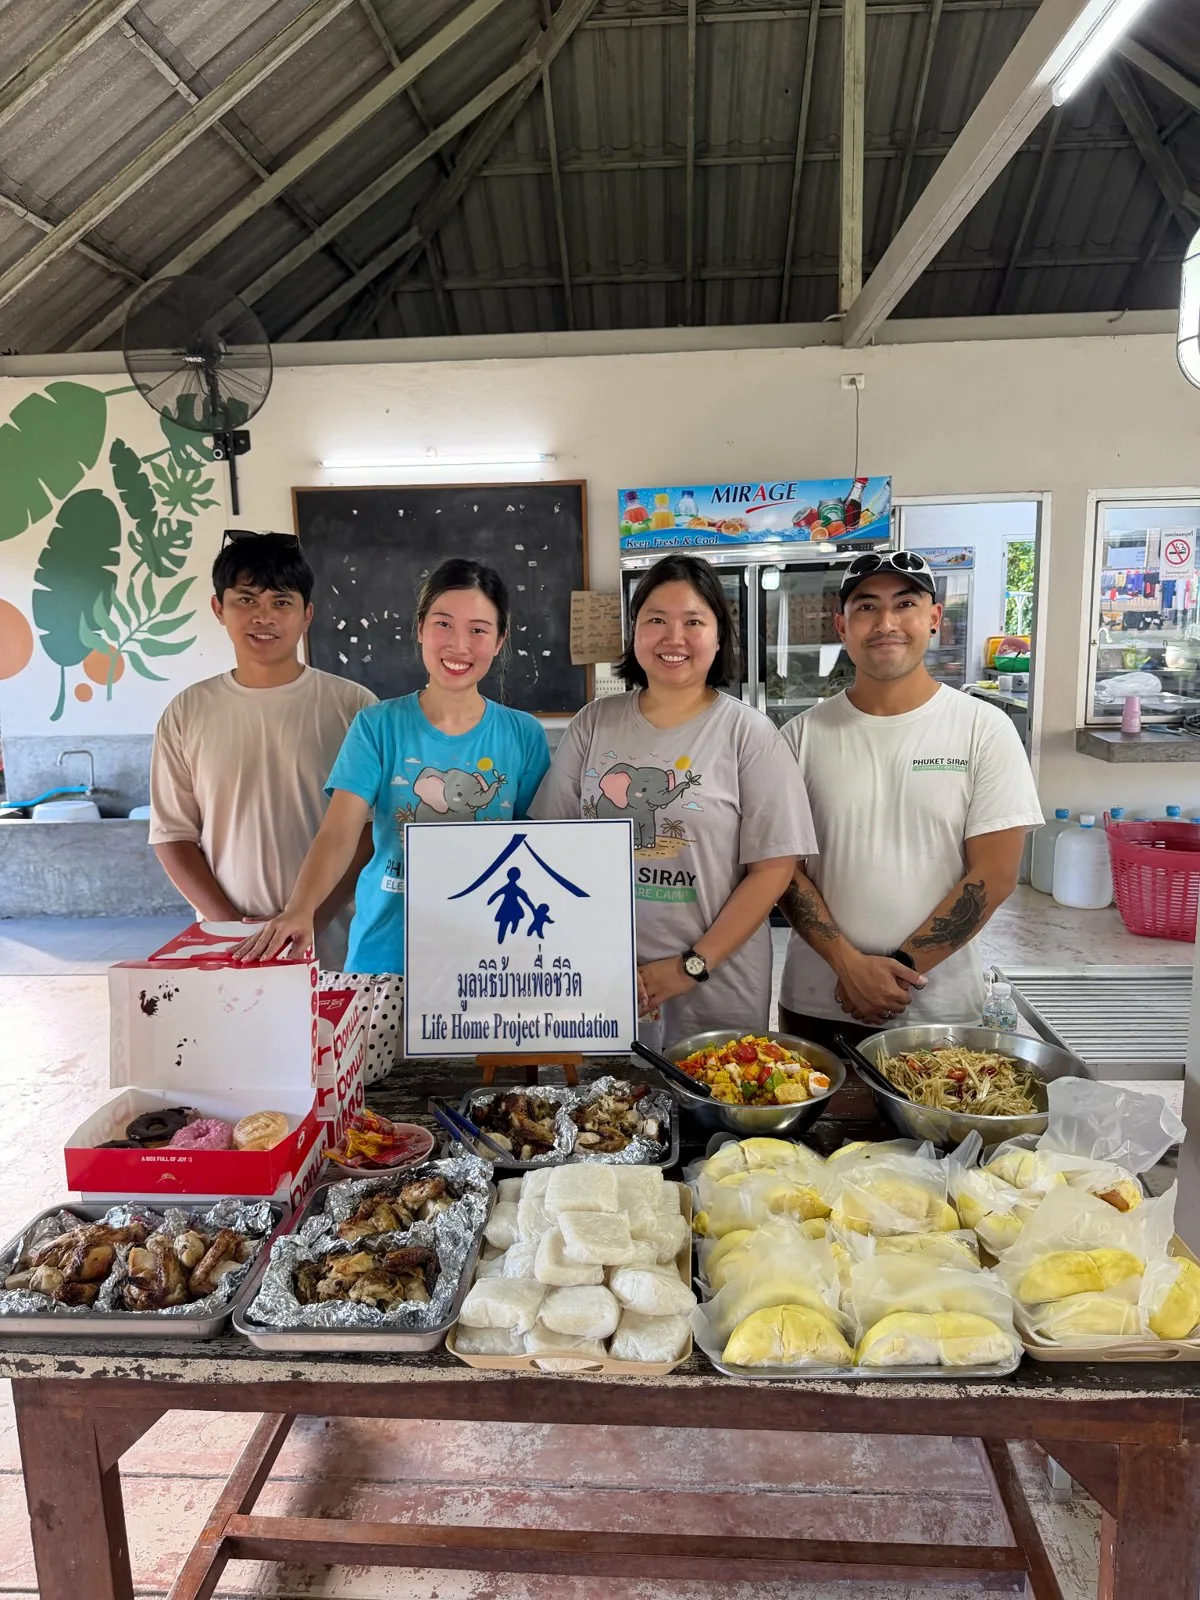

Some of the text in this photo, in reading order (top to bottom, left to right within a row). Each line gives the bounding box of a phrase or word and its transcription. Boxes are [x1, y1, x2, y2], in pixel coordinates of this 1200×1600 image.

[711, 482, 799, 504] MIRAGE
[626, 535, 719, 549] Keep Fresh & Cool
[912, 758, 969, 766] PHUKET SIRAY
[638, 866, 697, 887] SIRAY
[655, 889, 688, 901] CAMP
[457, 944, 582, 1012] มูลนิธิบ้านเพื่อชีวิต
[421, 1012, 619, 1047] Life Home Project Foundation
